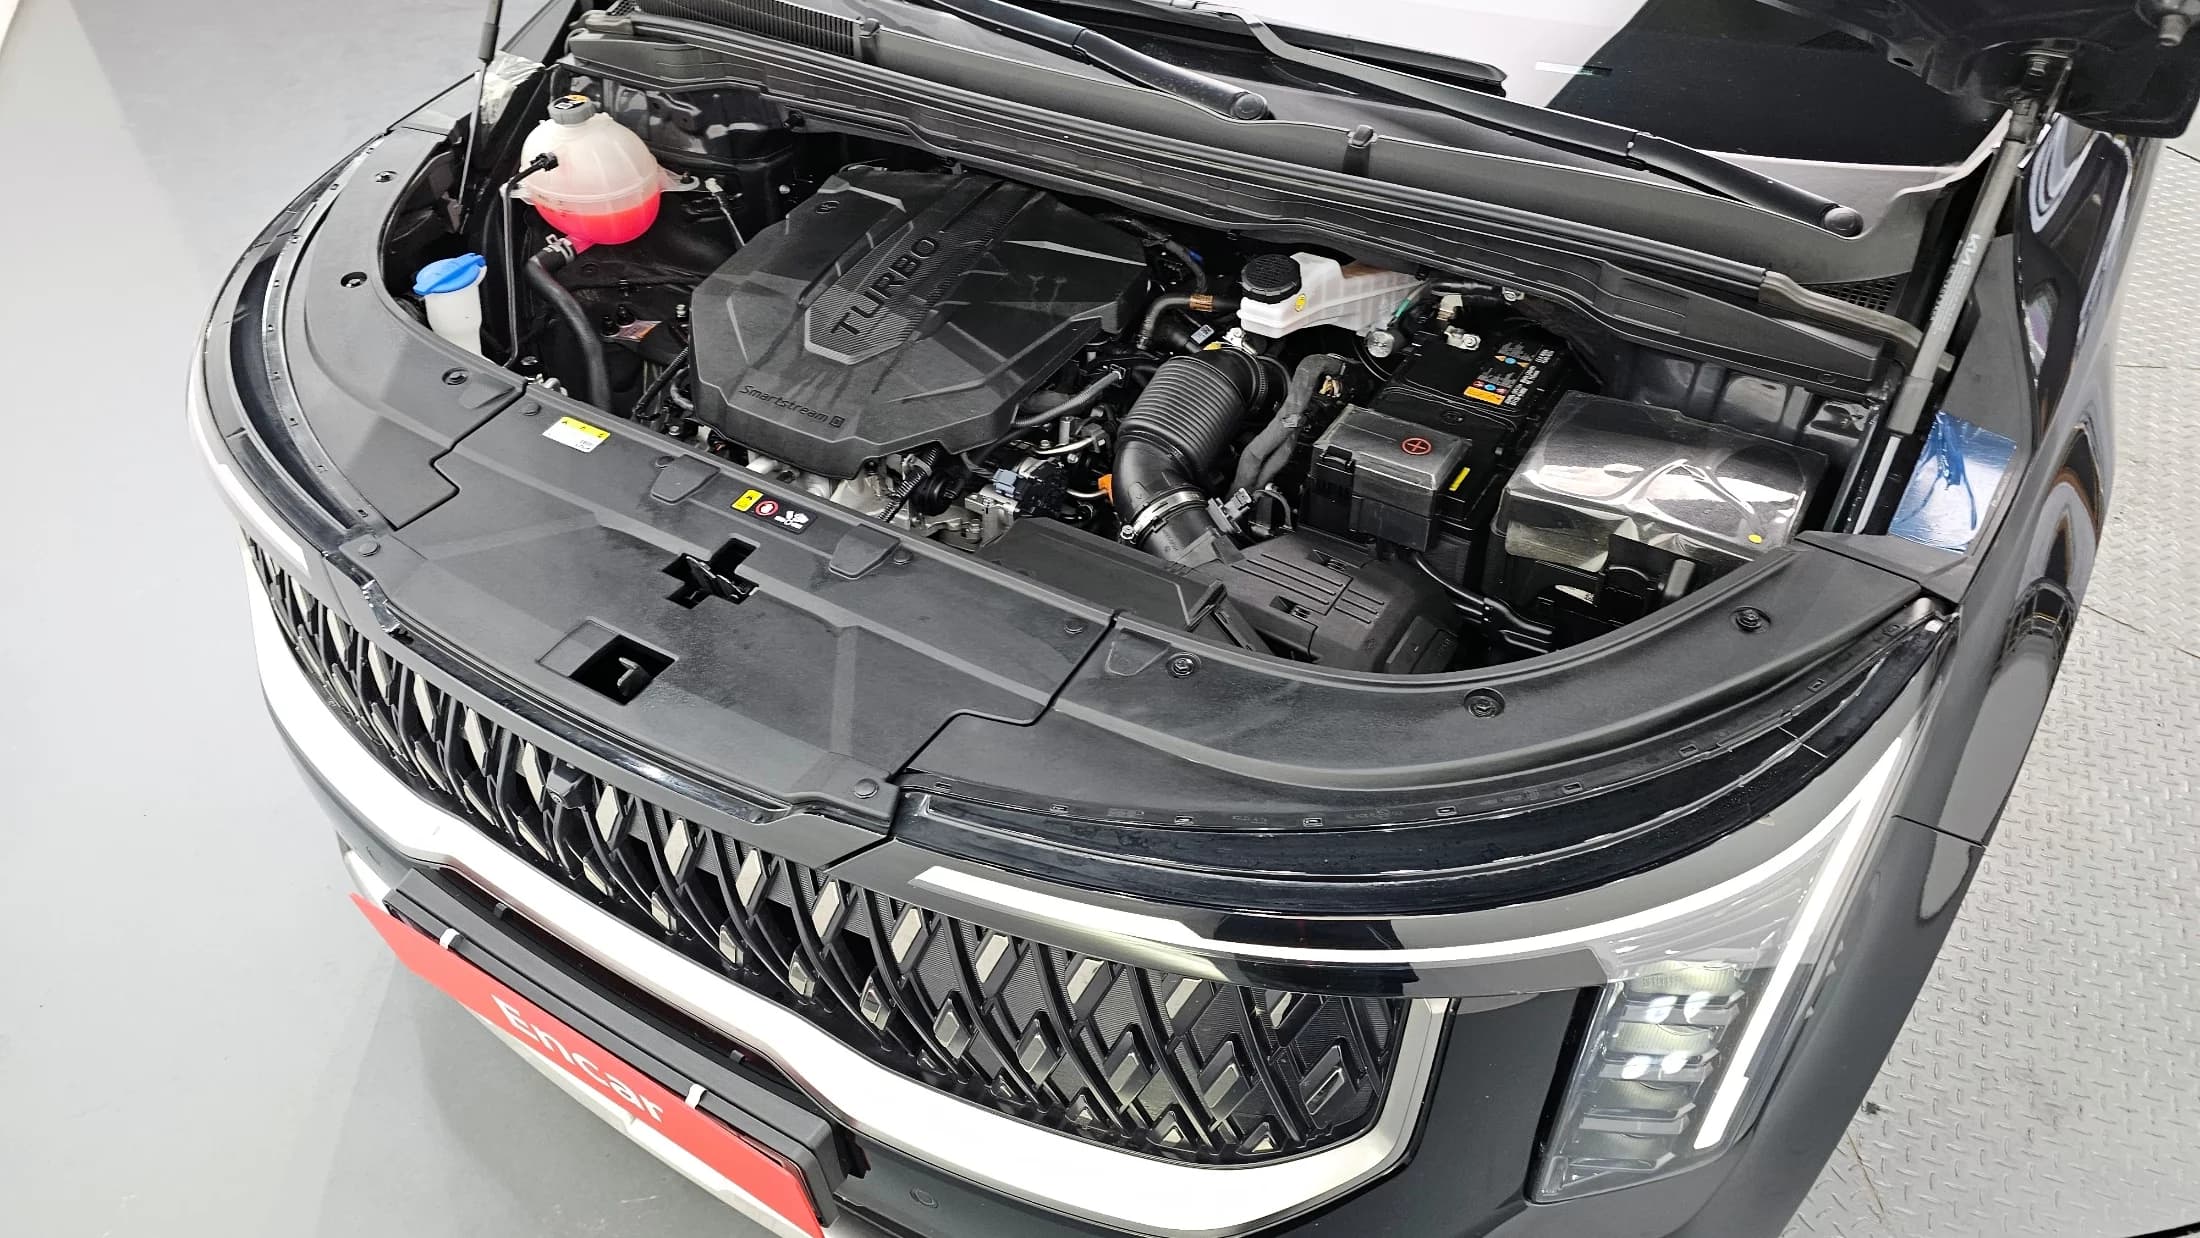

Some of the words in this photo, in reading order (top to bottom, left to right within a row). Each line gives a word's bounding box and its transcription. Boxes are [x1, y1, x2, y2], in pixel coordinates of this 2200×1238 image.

[830, 236, 939, 335] TURBO
[739, 385, 829, 423] Smartstream
[490, 994, 664, 1124] Encar
